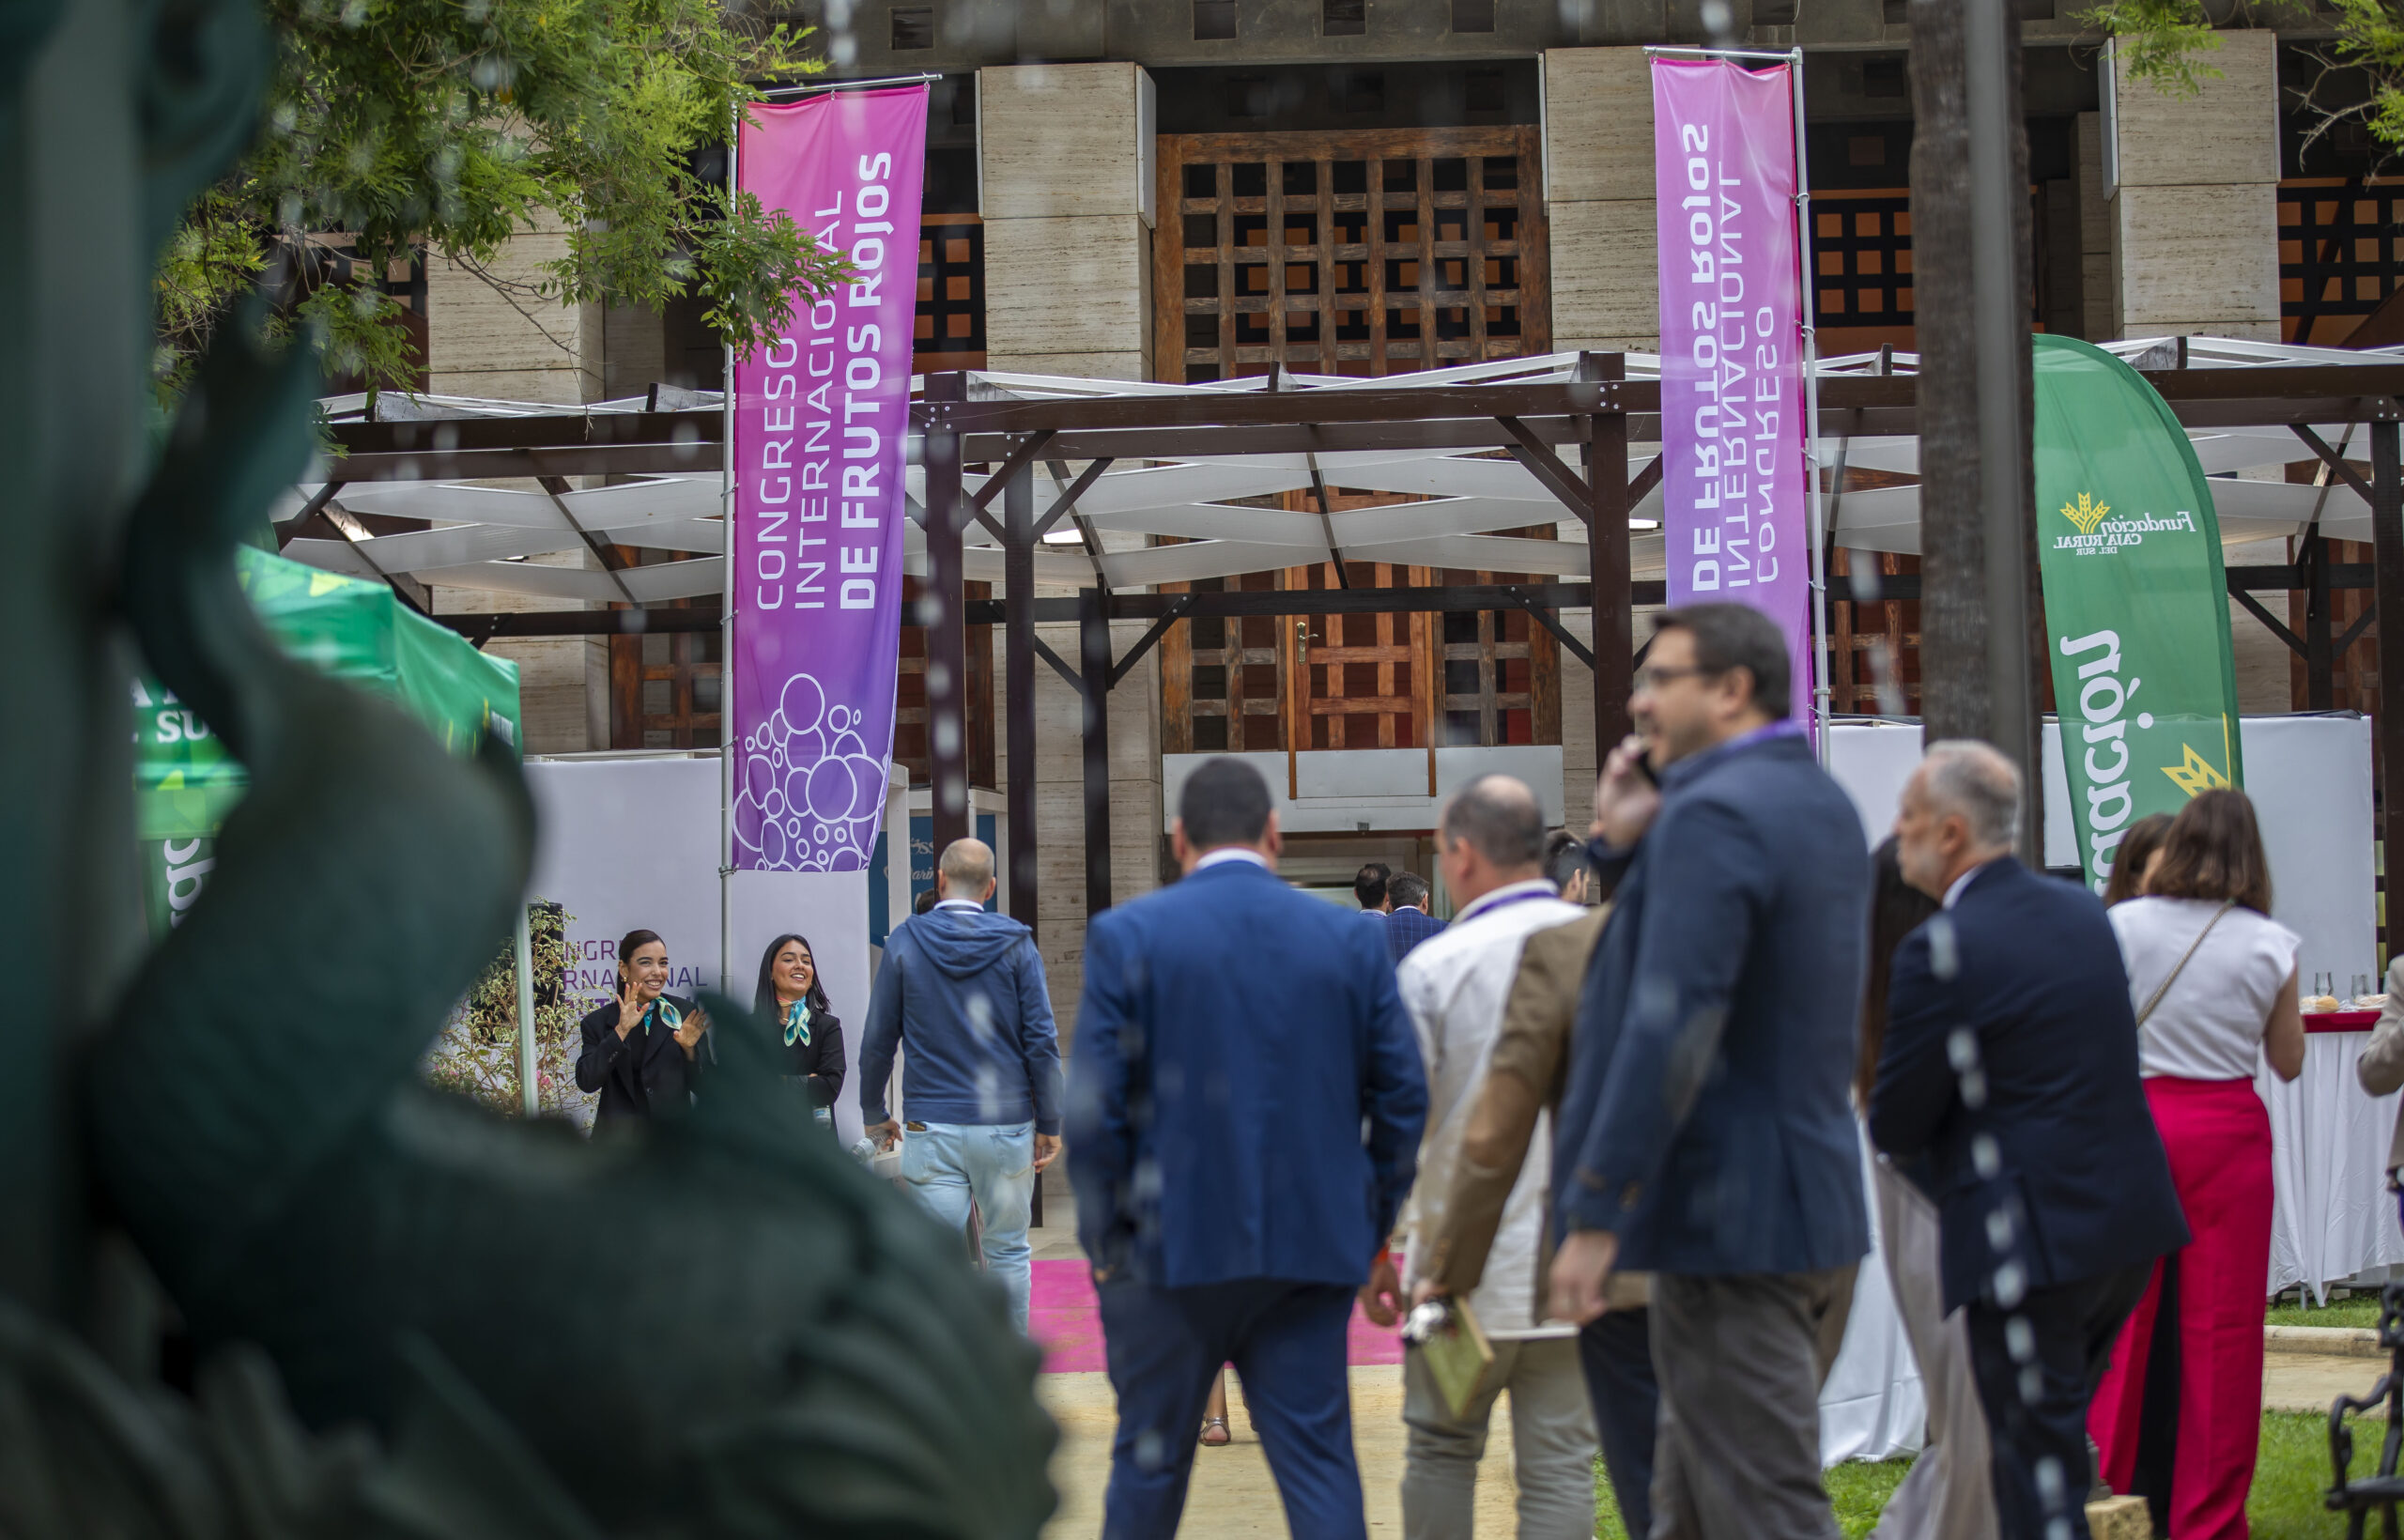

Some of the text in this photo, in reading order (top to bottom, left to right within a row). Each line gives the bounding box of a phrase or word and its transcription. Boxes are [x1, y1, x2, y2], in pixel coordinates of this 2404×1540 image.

[757, 338, 798, 609] CONGRESO
[840, 152, 894, 608] DE FRUTOS ROJOS
[157, 710, 216, 743] SU
